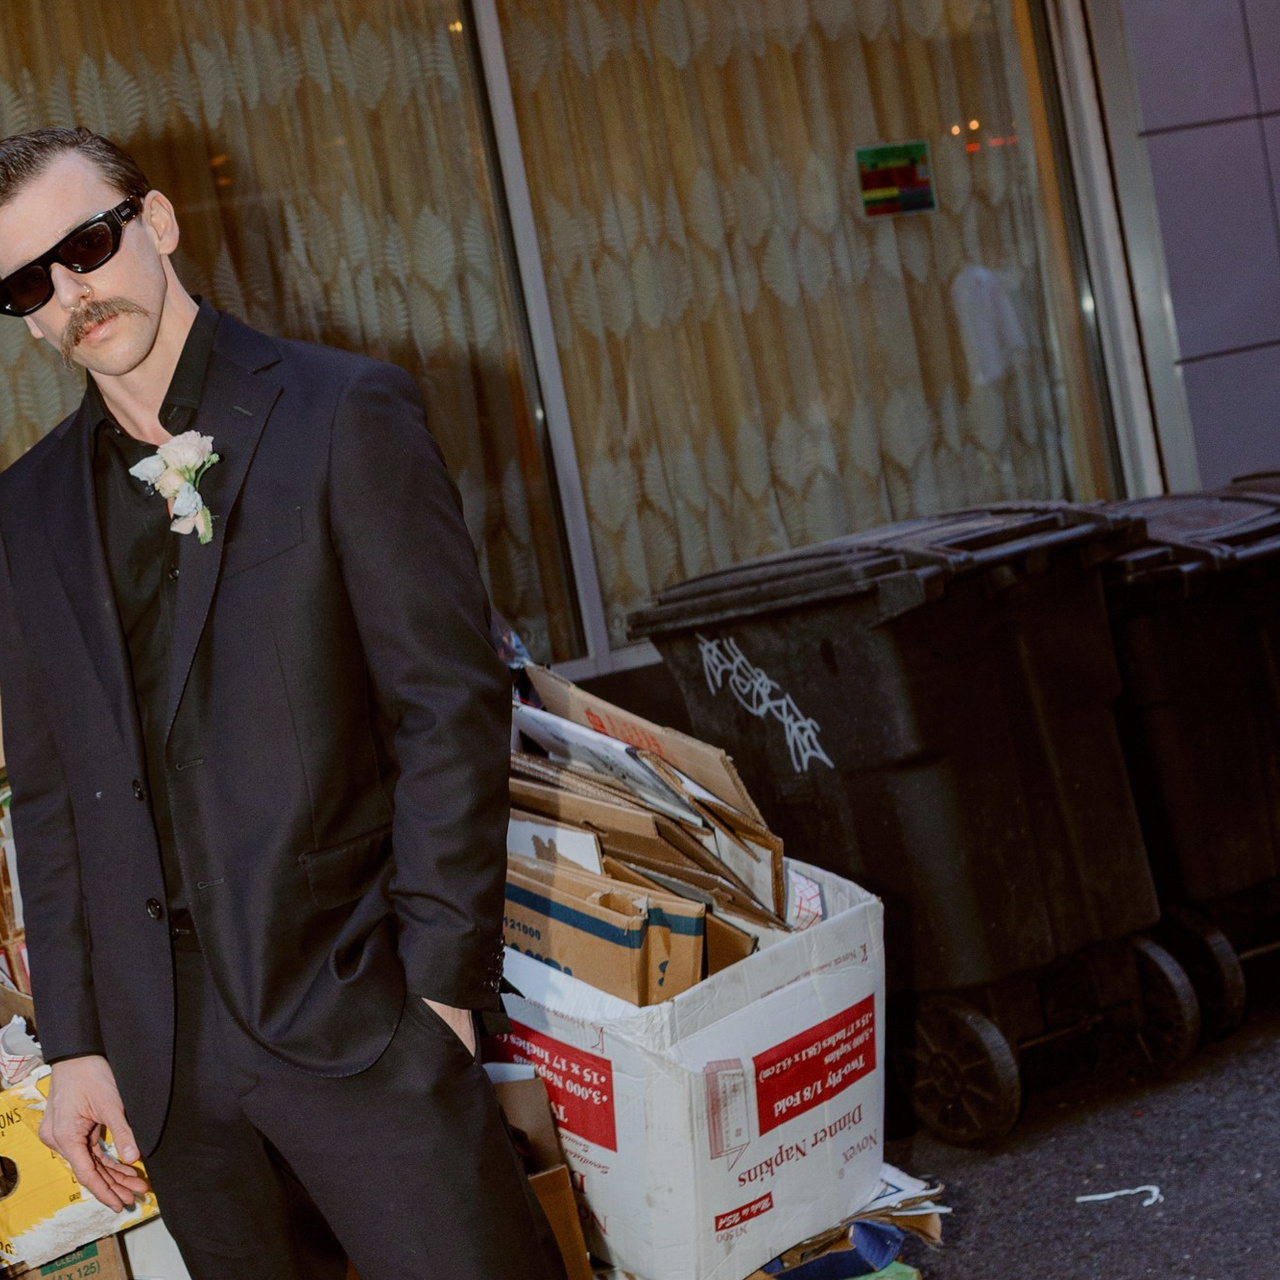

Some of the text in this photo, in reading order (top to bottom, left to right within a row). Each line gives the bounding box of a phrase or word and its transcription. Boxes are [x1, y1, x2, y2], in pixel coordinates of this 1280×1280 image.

[510, 1035, 551, 1063] Inches
[823, 1043, 849, 1065] Napkins
[513, 1054, 563, 1089] Napins
[551, 1055, 568, 1072] 17
[570, 1063, 580, 1075] x
[773, 1053, 866, 1118] Two-Ply 1/8 Fold
[737, 1103, 863, 1188] Dinner Napkins
[842, 1128, 878, 1164] Novex
[77, 1260, 101, 1280] 125)
